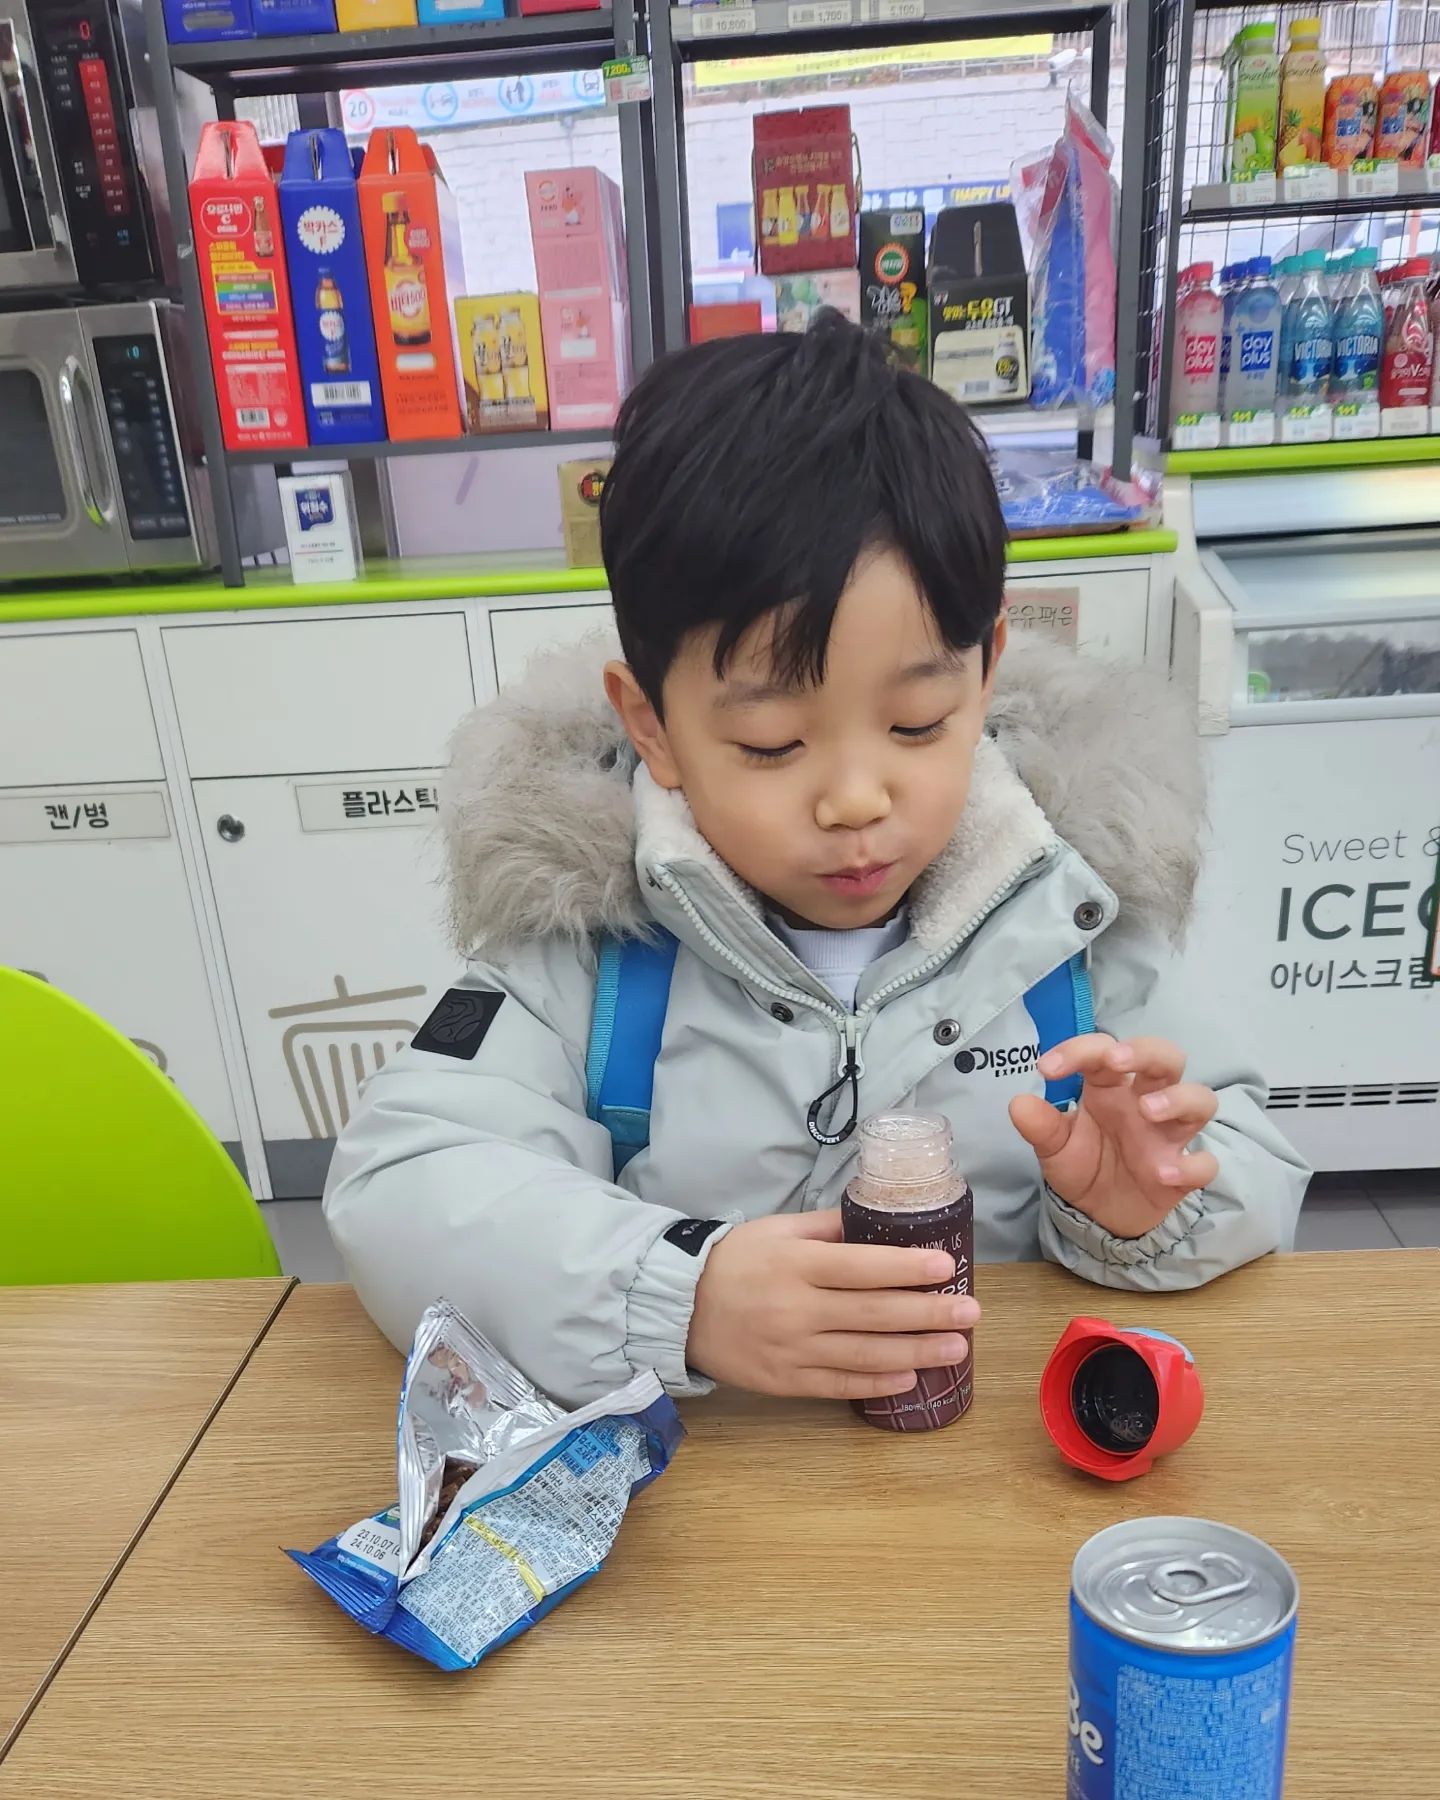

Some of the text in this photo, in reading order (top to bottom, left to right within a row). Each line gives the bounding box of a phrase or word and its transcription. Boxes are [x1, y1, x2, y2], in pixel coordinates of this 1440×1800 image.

[350, 101, 368, 118] 20
[304, 220, 338, 235] 박카스
[1242, 336, 1272, 353] day
[1337, 335, 1378, 357] VICTORIA
[1241, 352, 1271, 369] plus
[342, 787, 438, 818] 플라스틱
[44, 802, 109, 830] 캔/병
[1282, 830, 1408, 864] Sweet
[808, 1121, 840, 1144] DISCOVERY
[951, 1231, 962, 1251] US
[350, 1538, 386, 1560] 24.10.06
[357, 1529, 394, 1551] 23.10.07
